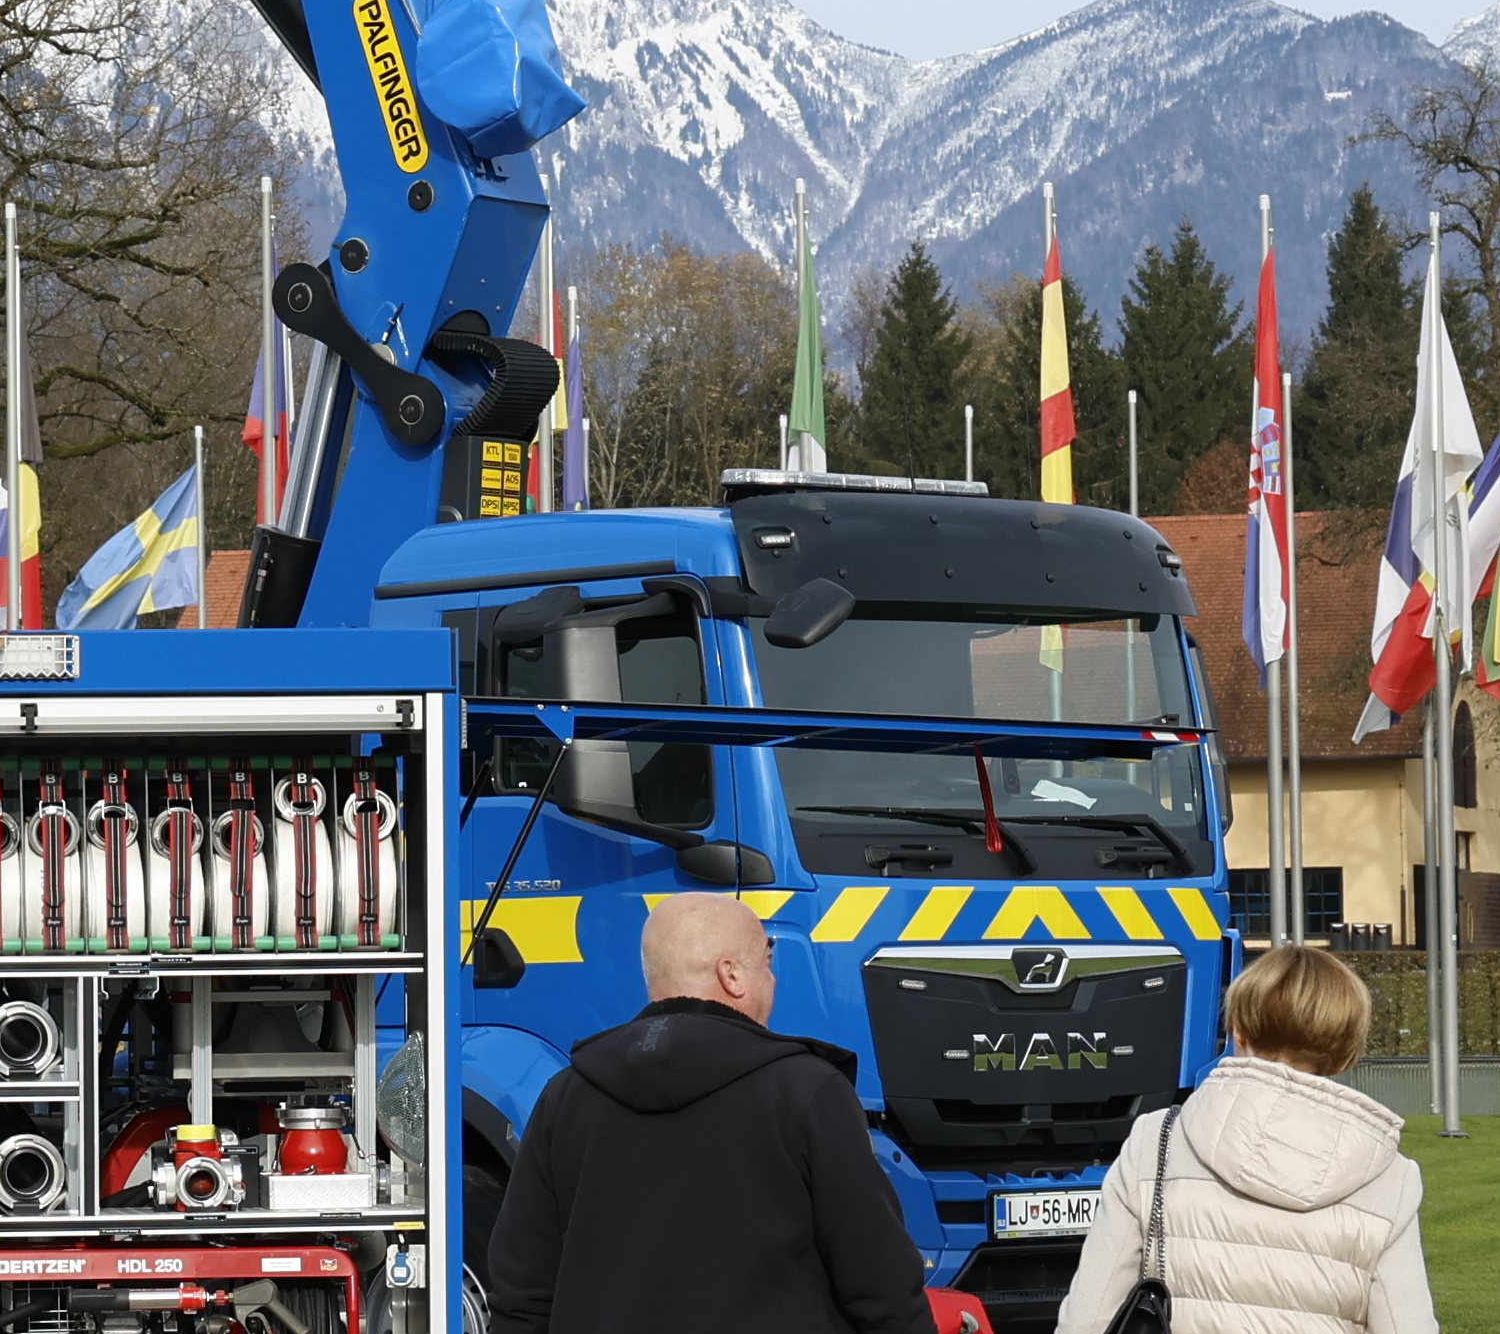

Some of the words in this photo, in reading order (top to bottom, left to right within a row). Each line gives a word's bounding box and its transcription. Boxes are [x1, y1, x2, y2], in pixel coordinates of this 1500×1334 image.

[46, 774, 56, 784] B
[108, 773, 118, 783] B
[172, 772, 182, 782] B
[235, 772, 245, 782] B
[297, 773, 307, 783] B
[359, 771, 369, 781] B
[973, 1032, 1107, 1071] MAN
[1008, 1200, 1028, 1225] LJ
[117, 1259, 152, 1274] HDL
[154, 1258, 183, 1273] 250
